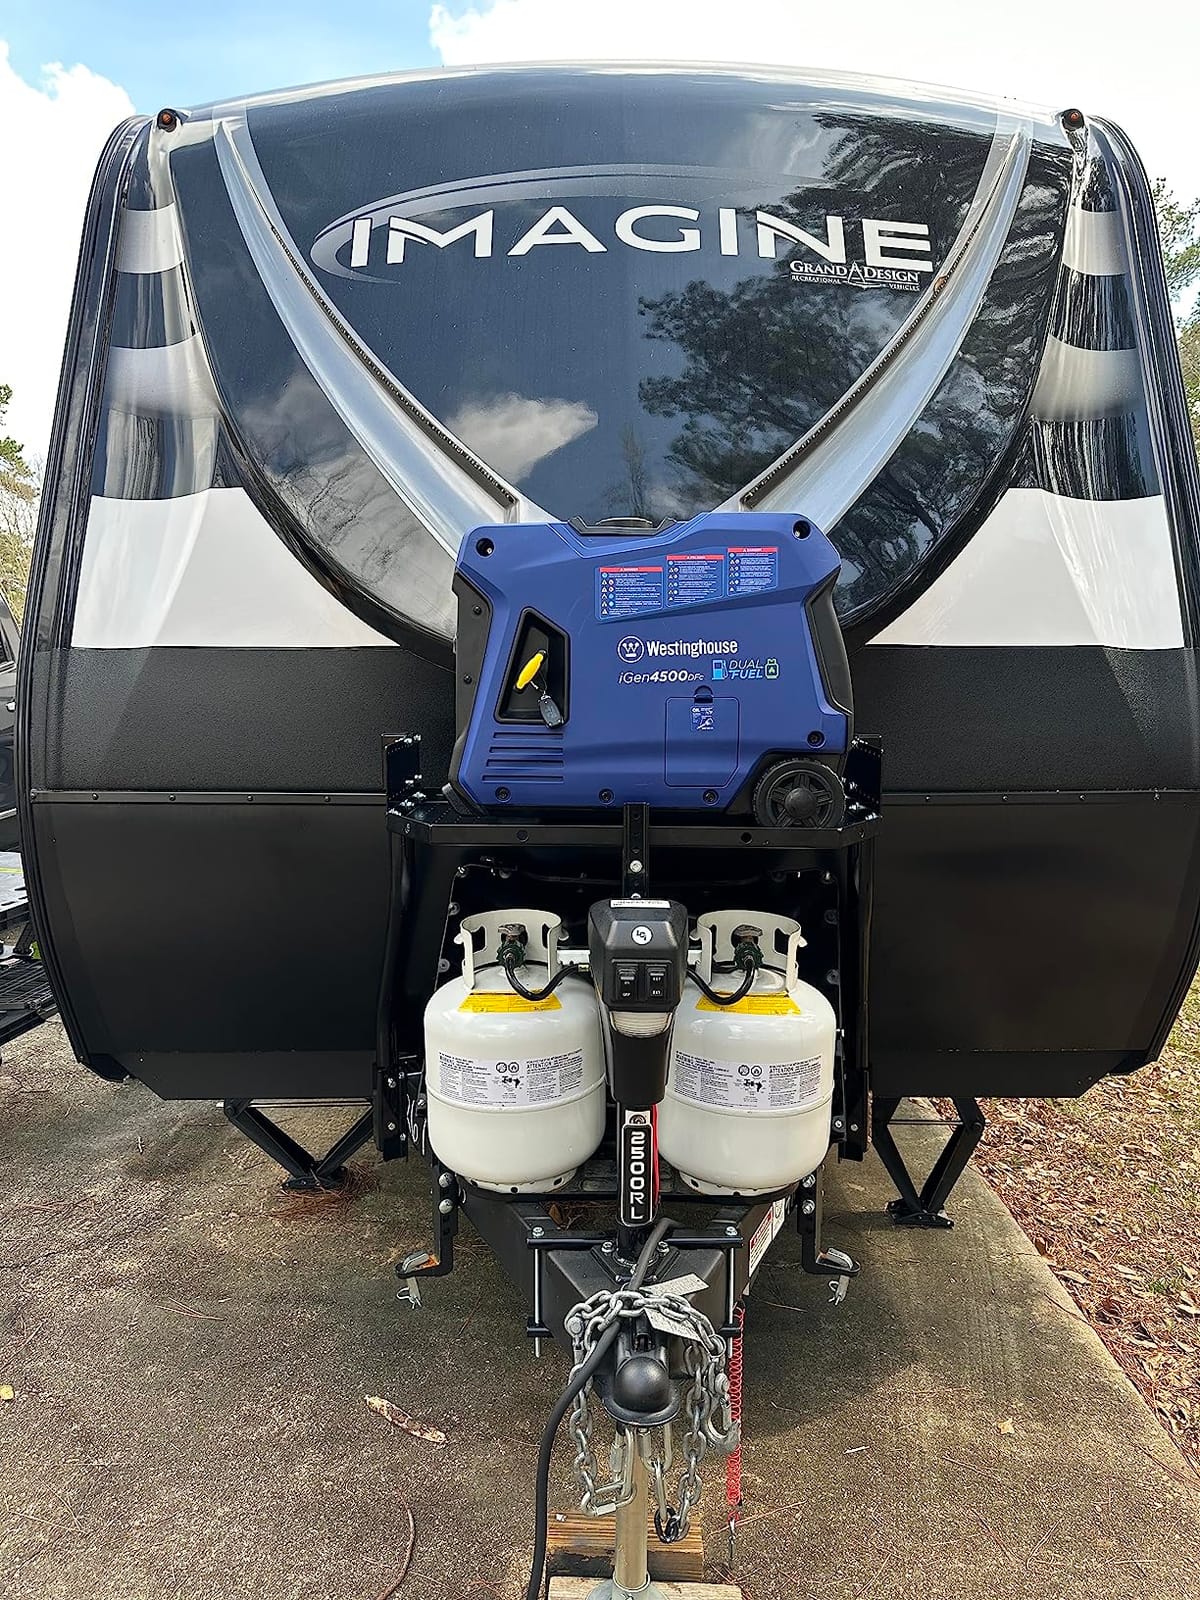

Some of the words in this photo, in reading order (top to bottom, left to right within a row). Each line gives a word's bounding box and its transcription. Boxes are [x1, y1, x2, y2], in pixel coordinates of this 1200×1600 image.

[350, 205, 933, 272] IMAGINE
[790, 260, 847, 275] GRAND
[864, 265, 919, 282] DESIGN
[647, 639, 738, 658] Westinghouse
[728, 669, 763, 680] FUEL
[729, 659, 764, 670] DUAL
[629, 1130, 646, 1220] 2500RL
